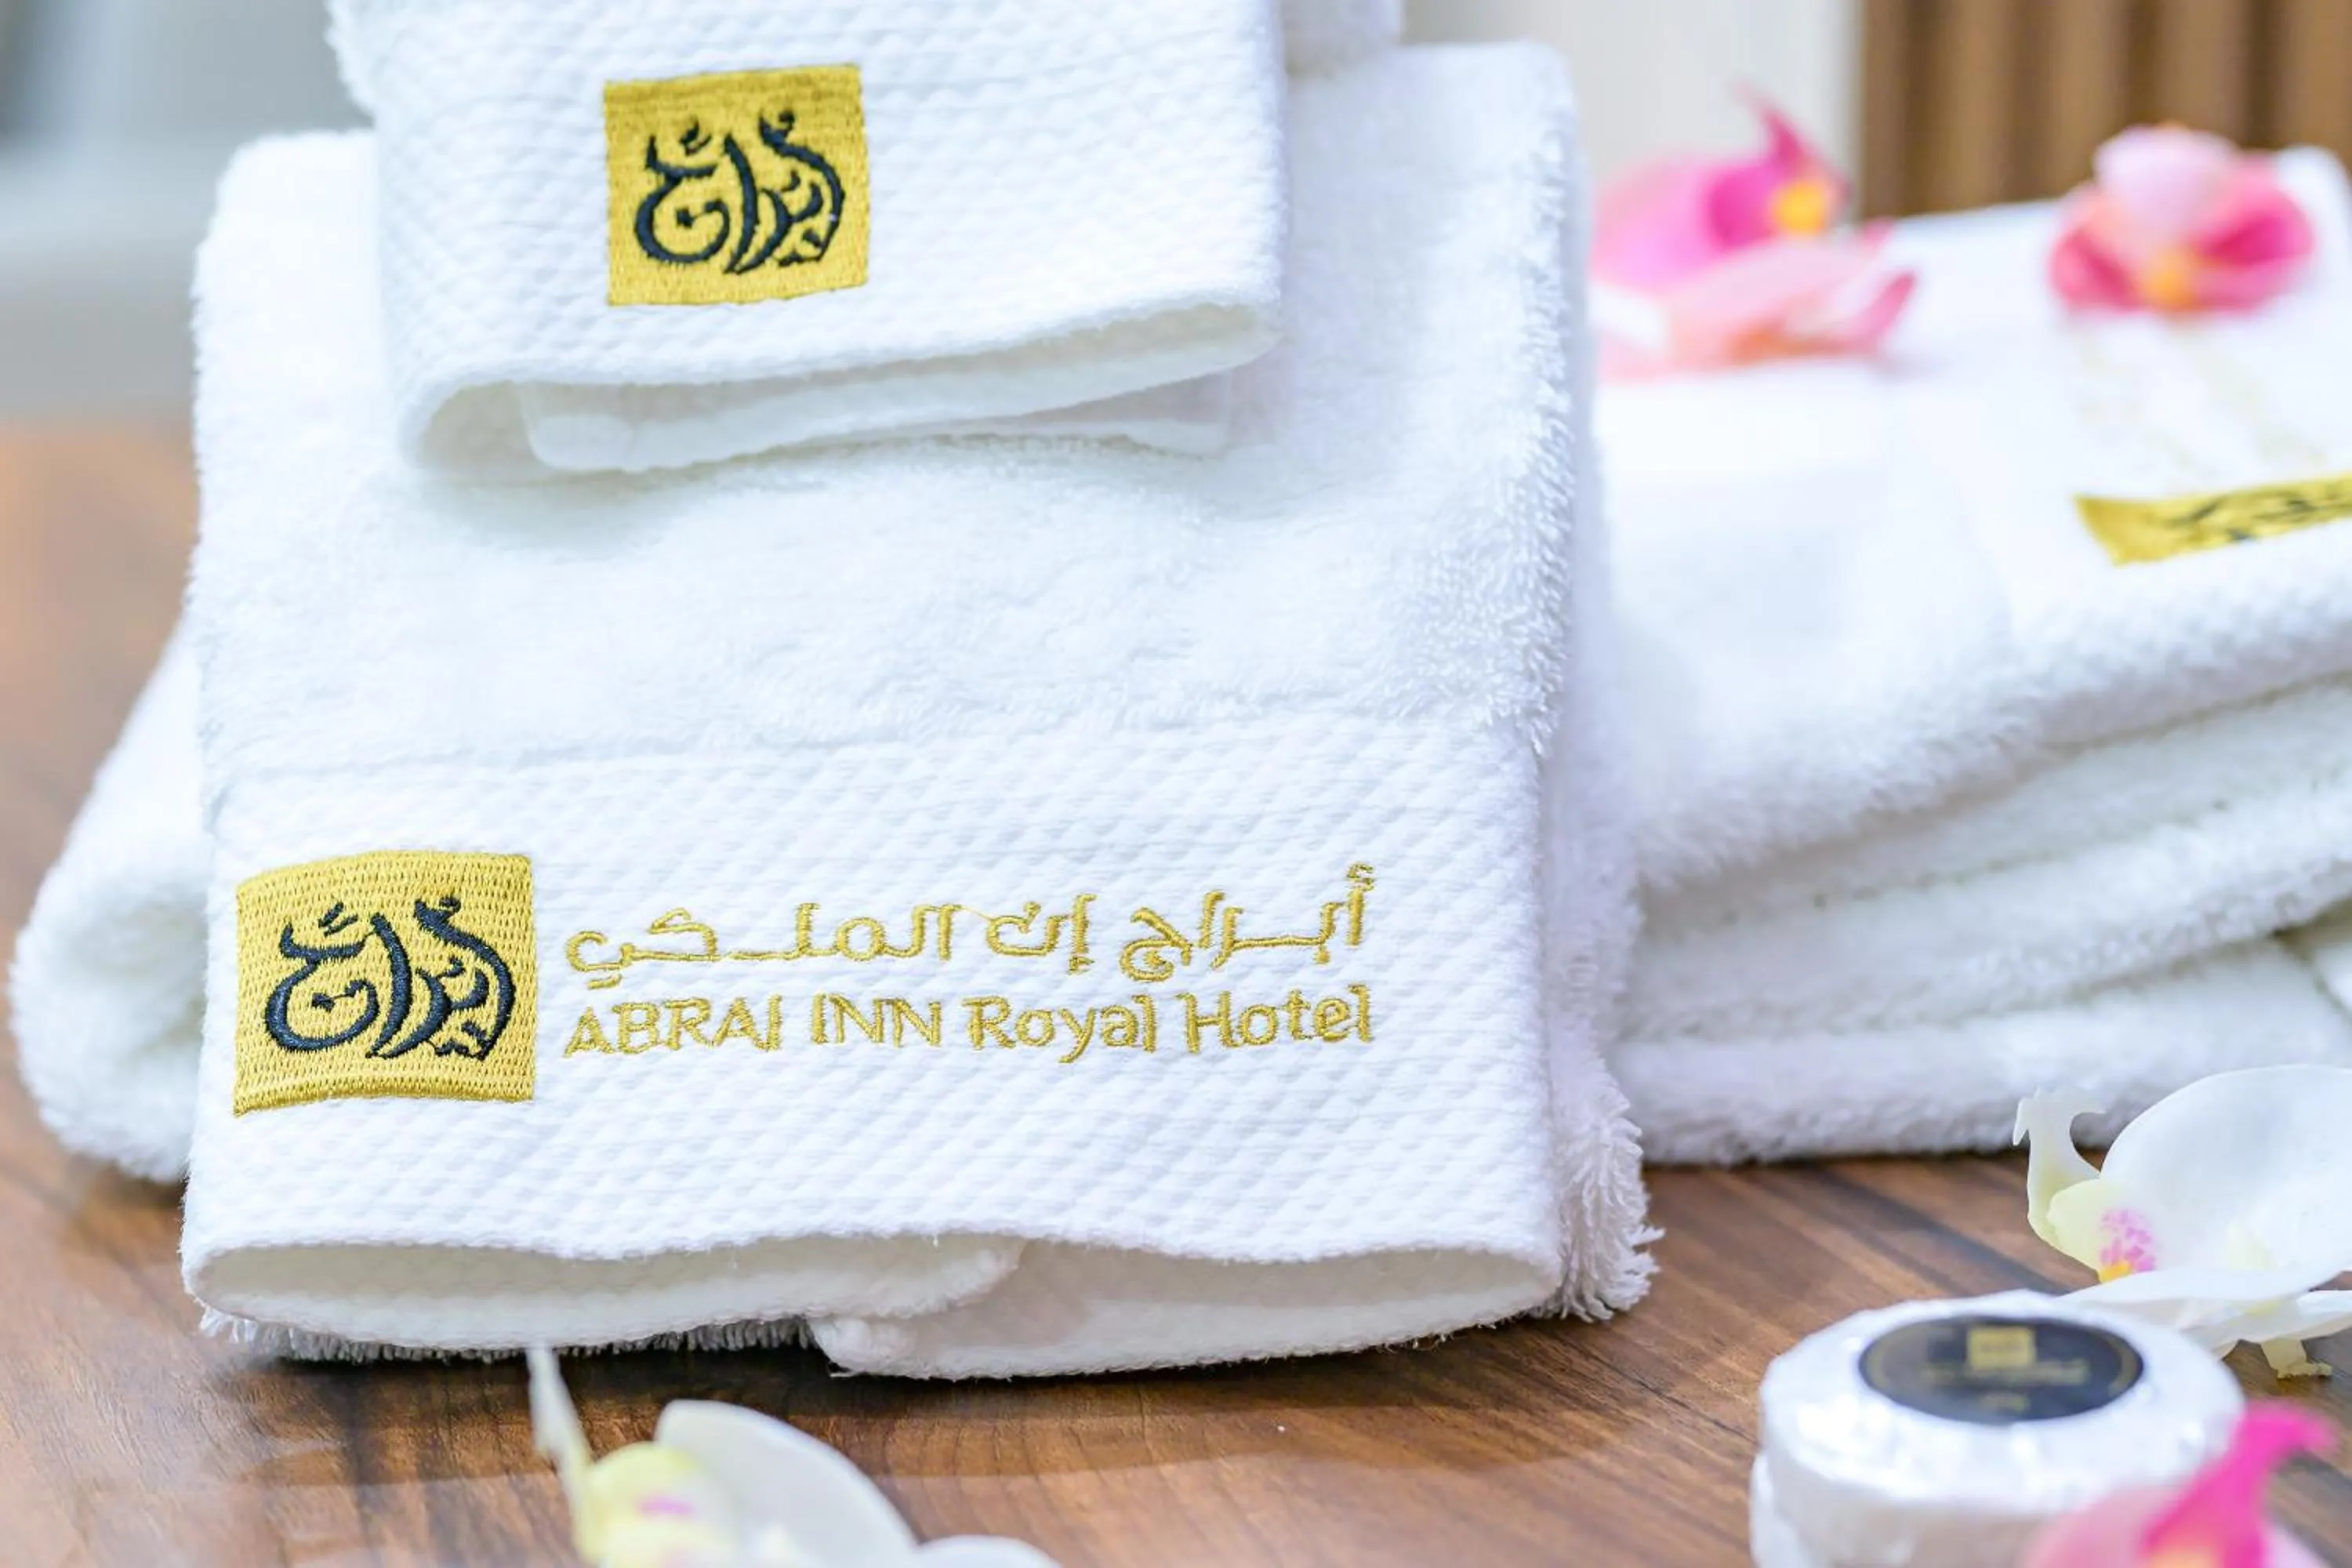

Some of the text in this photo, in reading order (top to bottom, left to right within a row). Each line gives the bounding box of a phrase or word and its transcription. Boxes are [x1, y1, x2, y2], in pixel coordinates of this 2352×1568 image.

[1120, 862, 1374, 982] أبراج
[812, 993, 942, 1047] INN
[962, 993, 1157, 1064] Royal
[1176, 984, 1371, 1054] Hotel
